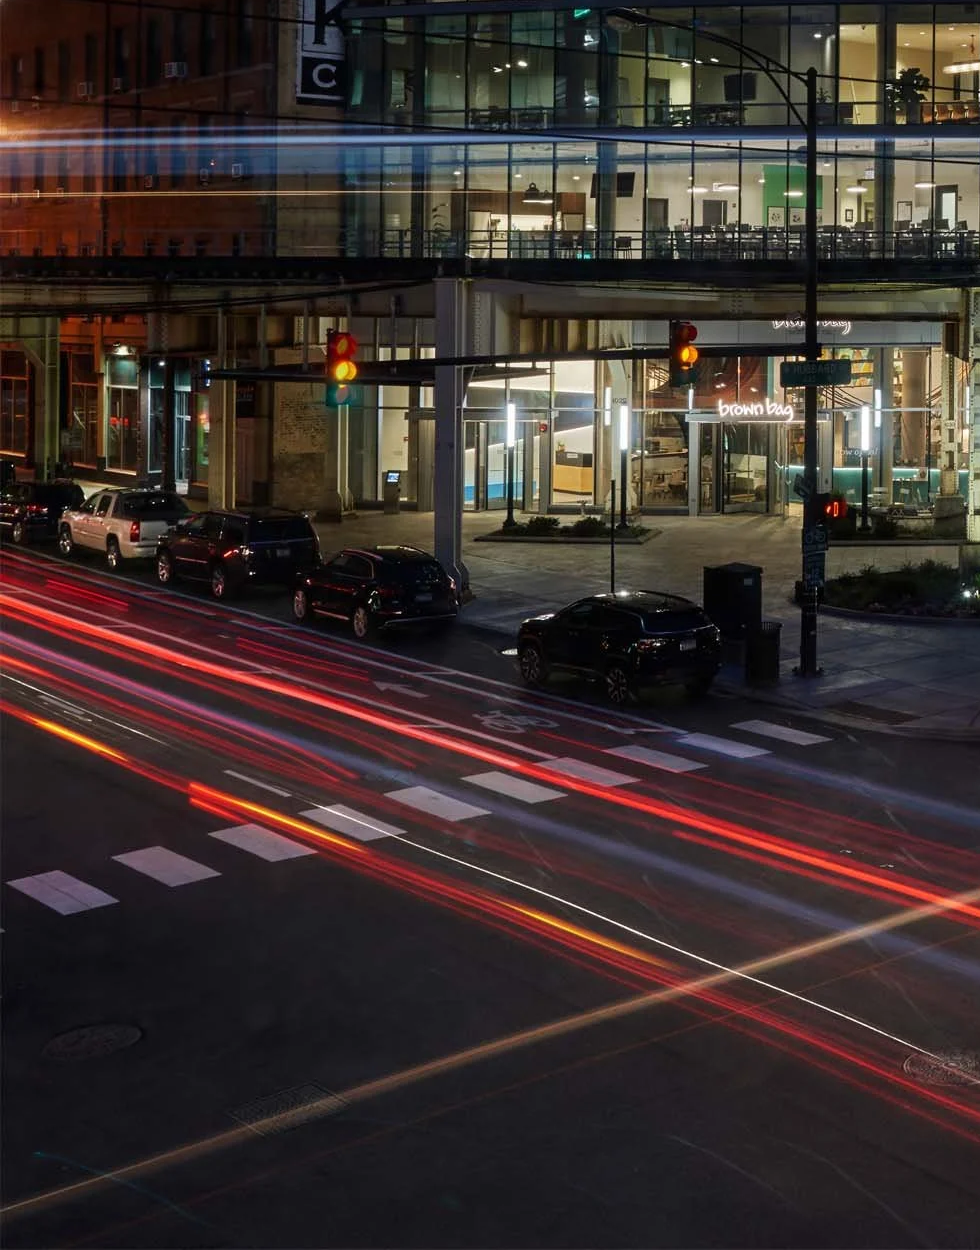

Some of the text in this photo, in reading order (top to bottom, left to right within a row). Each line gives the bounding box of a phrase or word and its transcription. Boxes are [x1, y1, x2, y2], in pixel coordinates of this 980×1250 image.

[311, 63, 337, 89] C
[718, 398, 794, 421] brown bag
